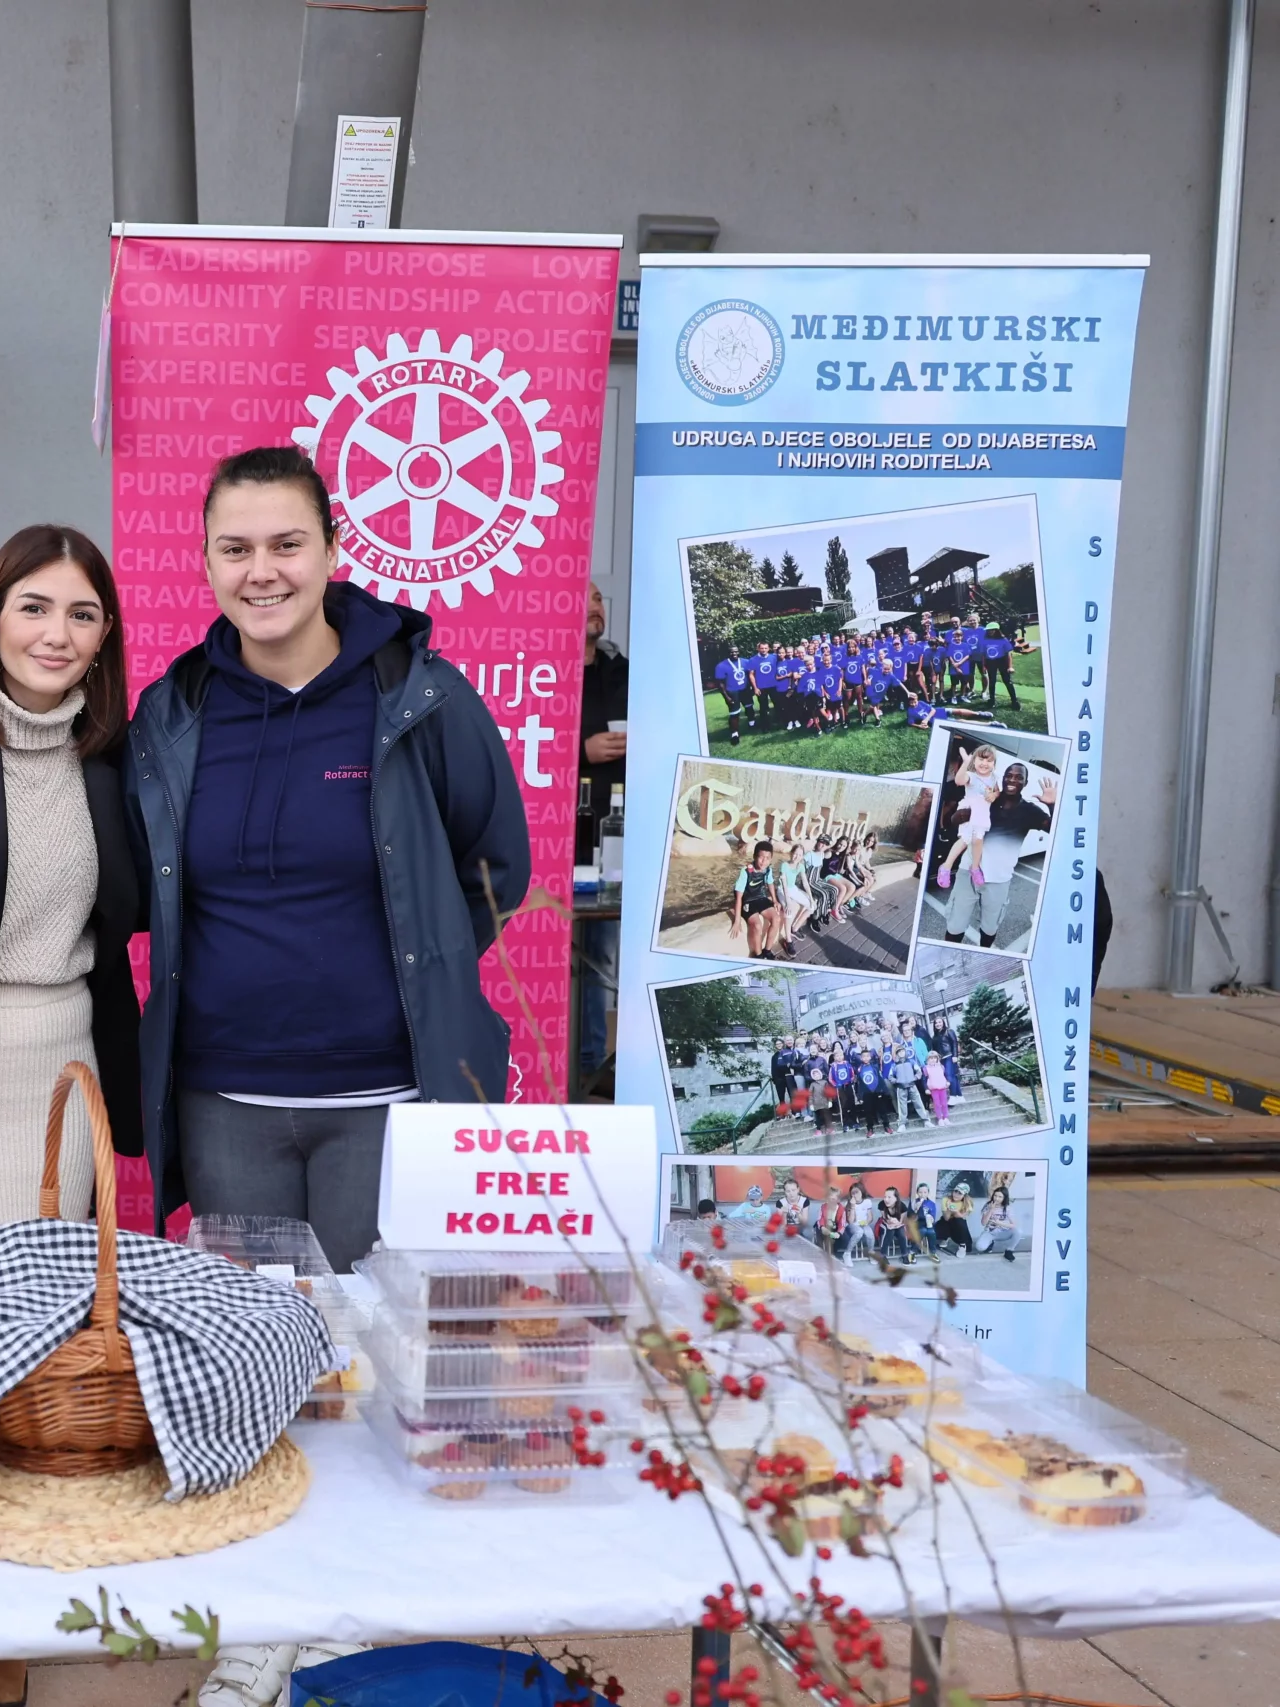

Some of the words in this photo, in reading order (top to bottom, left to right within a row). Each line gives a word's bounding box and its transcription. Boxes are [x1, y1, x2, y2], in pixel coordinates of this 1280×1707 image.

[120, 246, 311, 274] LEADERSHIP
[344, 250, 486, 277] PURPOSE
[532, 254, 612, 280] LOVE
[120, 281, 288, 309] COMUNITY
[299, 285, 481, 314] FRIENDSHIP
[494, 288, 610, 316] ACTION
[705, 301, 749, 315] DIJABETESA
[120, 320, 283, 348] INTEGRITY
[472, 327, 607, 354] PROJECT
[120, 359, 307, 387] EXPERIENCE
[371, 361, 486, 394] ROTARY
[815, 351, 1074, 392] SLATKIŠI
[120, 396, 215, 422] UNITY
[671, 430, 757, 447] UDRUGA
[761, 431, 825, 448] DJECE
[829, 431, 932, 449] OBOLJELE
[942, 433, 972, 450] OD
[977, 433, 1097, 450] DIJABETESA
[777, 452, 783, 468] I
[788, 452, 875, 469] NJIHOVIH
[881, 454, 992, 470] RODITELJA
[336, 514, 521, 581] INTERNATIONAL
[117, 584, 222, 609] TRAVE
[494, 589, 587, 614] VISION
[436, 626, 586, 652] DIVERSITY
[324, 770, 368, 780] Rotaract
[677, 778, 871, 846] Gardaland
[453, 1128, 591, 1154] SUGAR
[476, 1172, 569, 1196] FREE
[446, 1208, 594, 1236] KOLAČI
